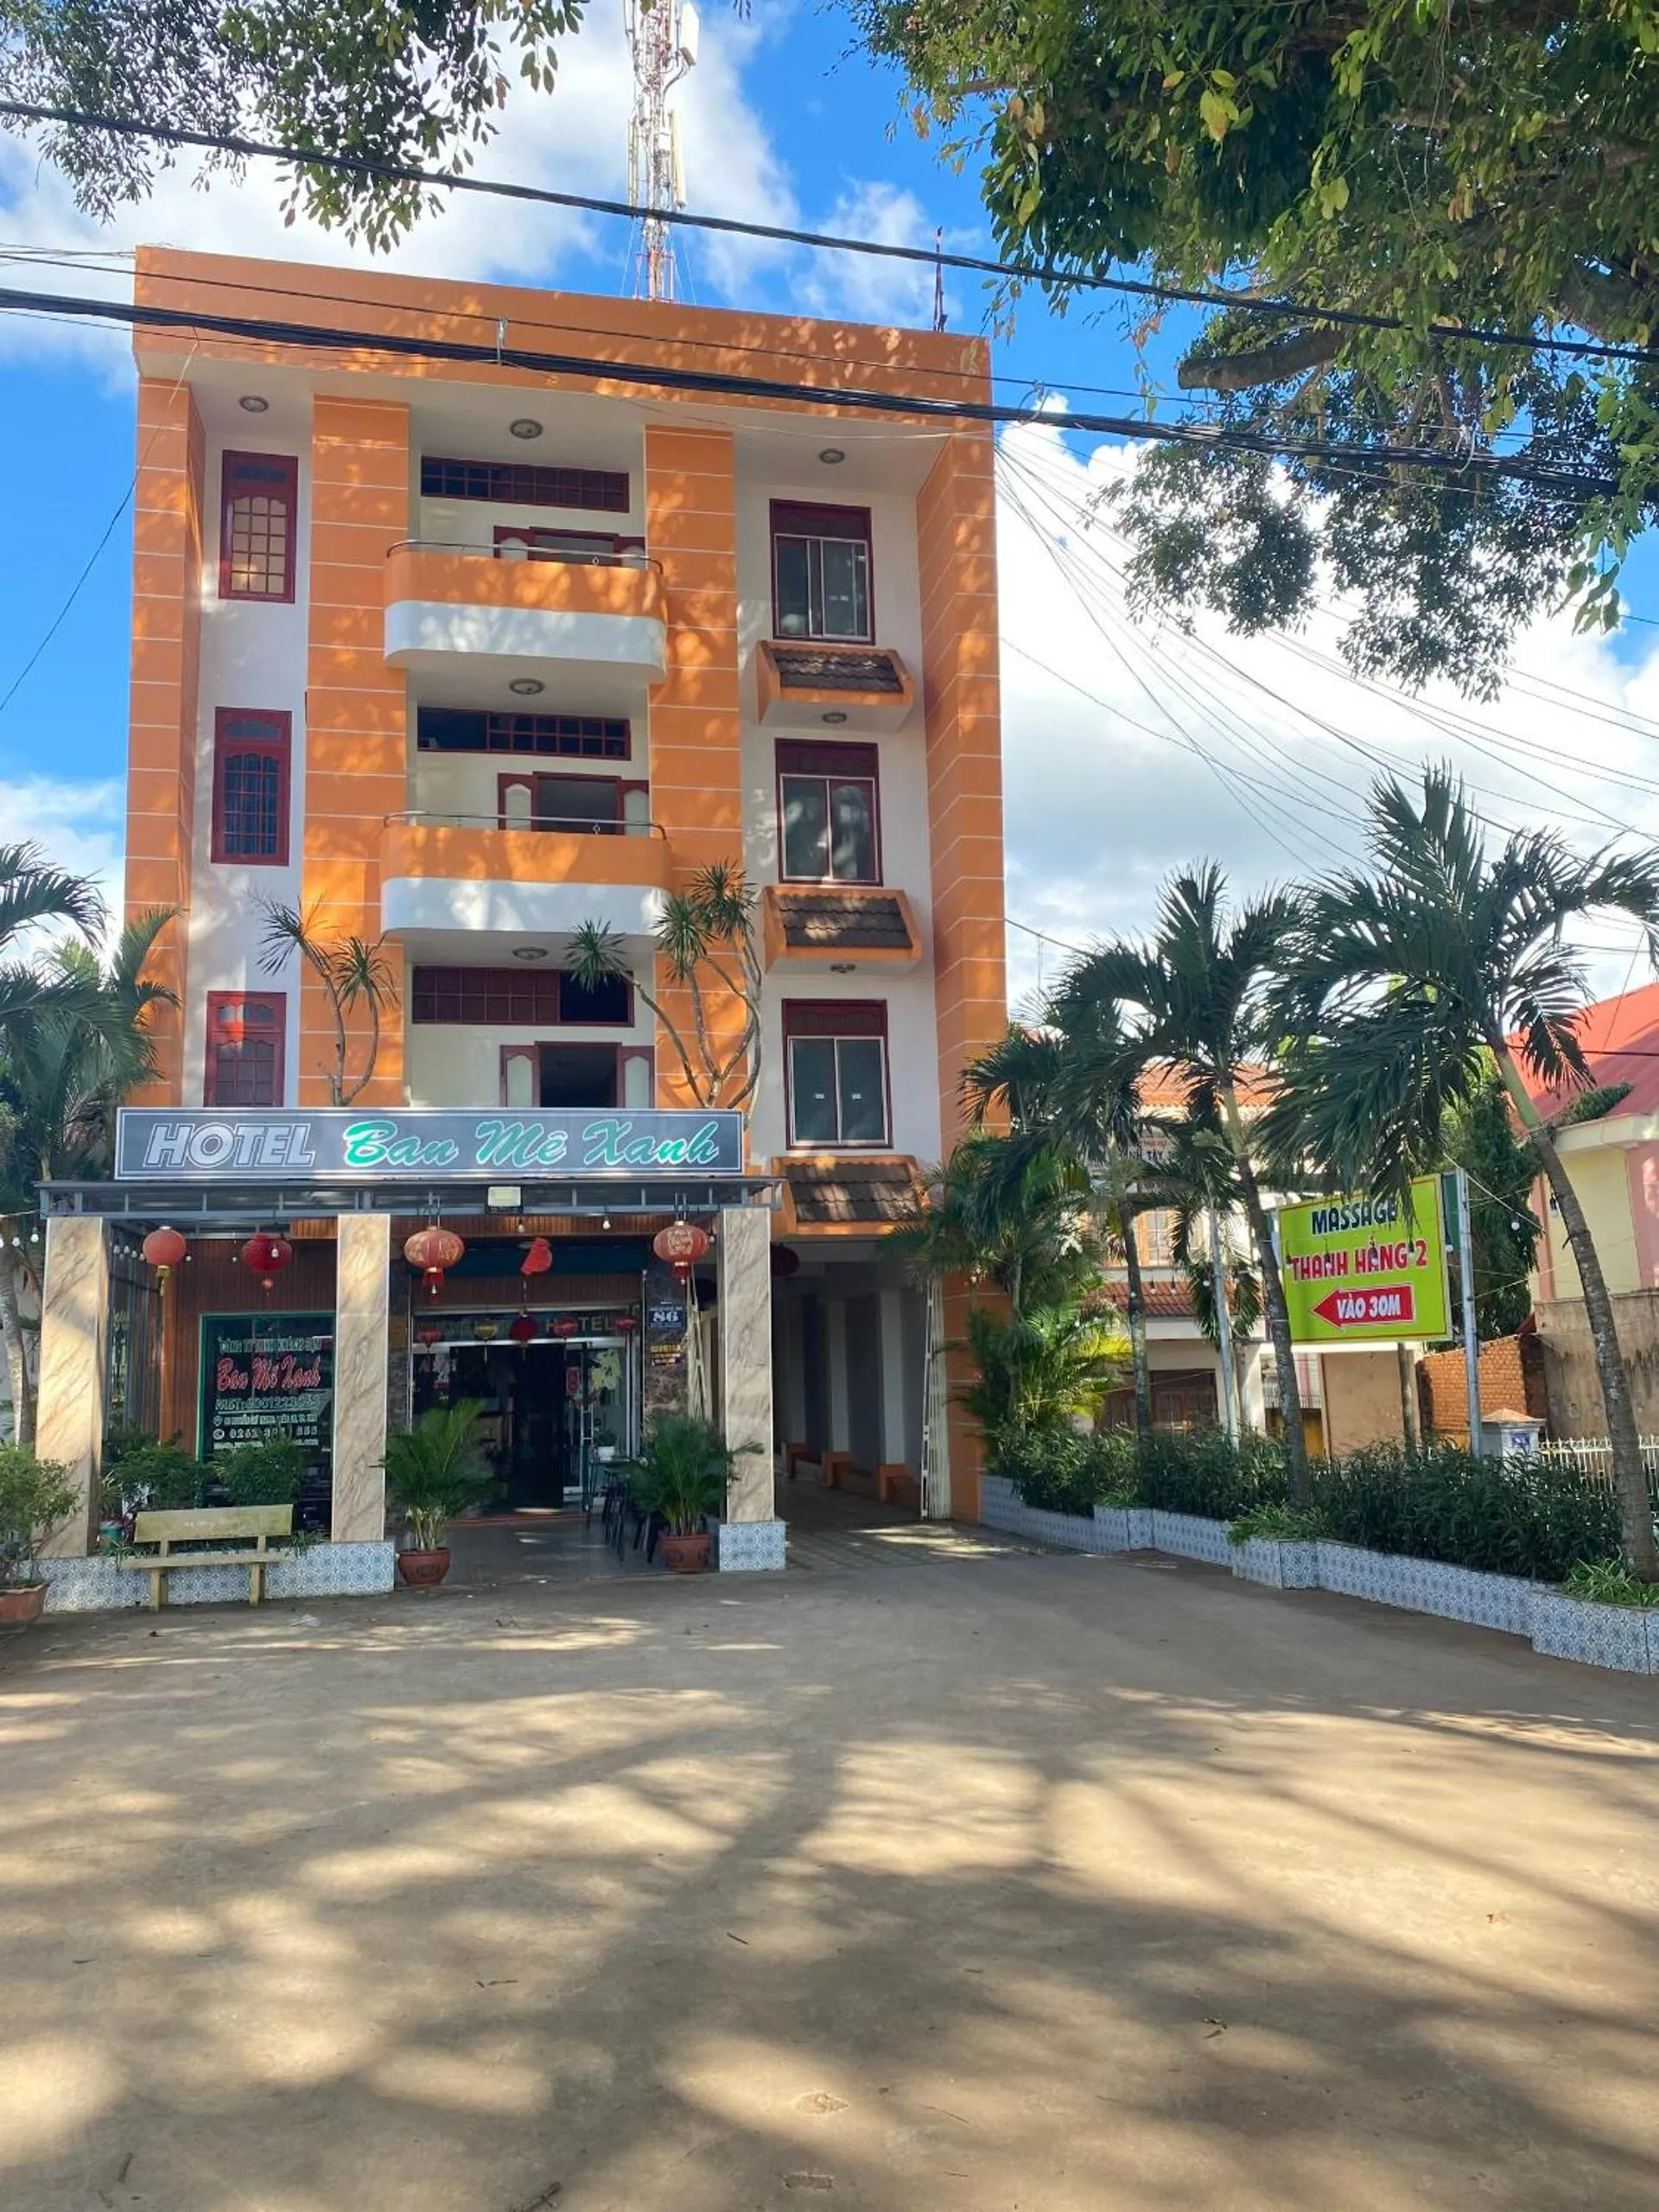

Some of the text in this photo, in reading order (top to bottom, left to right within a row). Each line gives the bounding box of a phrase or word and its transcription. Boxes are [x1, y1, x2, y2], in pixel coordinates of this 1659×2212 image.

[143, 1119, 719, 1167] HOTEL Ban Mê Xanh
[1311, 1198, 1397, 1236] MASSAGE
[1292, 1249, 1350, 1282] THANH
[1414, 1239, 1428, 1268] 2
[1337, 1293, 1401, 1319] VÀO 30M
[545, 1315, 614, 1334] HTEL
[217, 1357, 249, 1391] Ban
